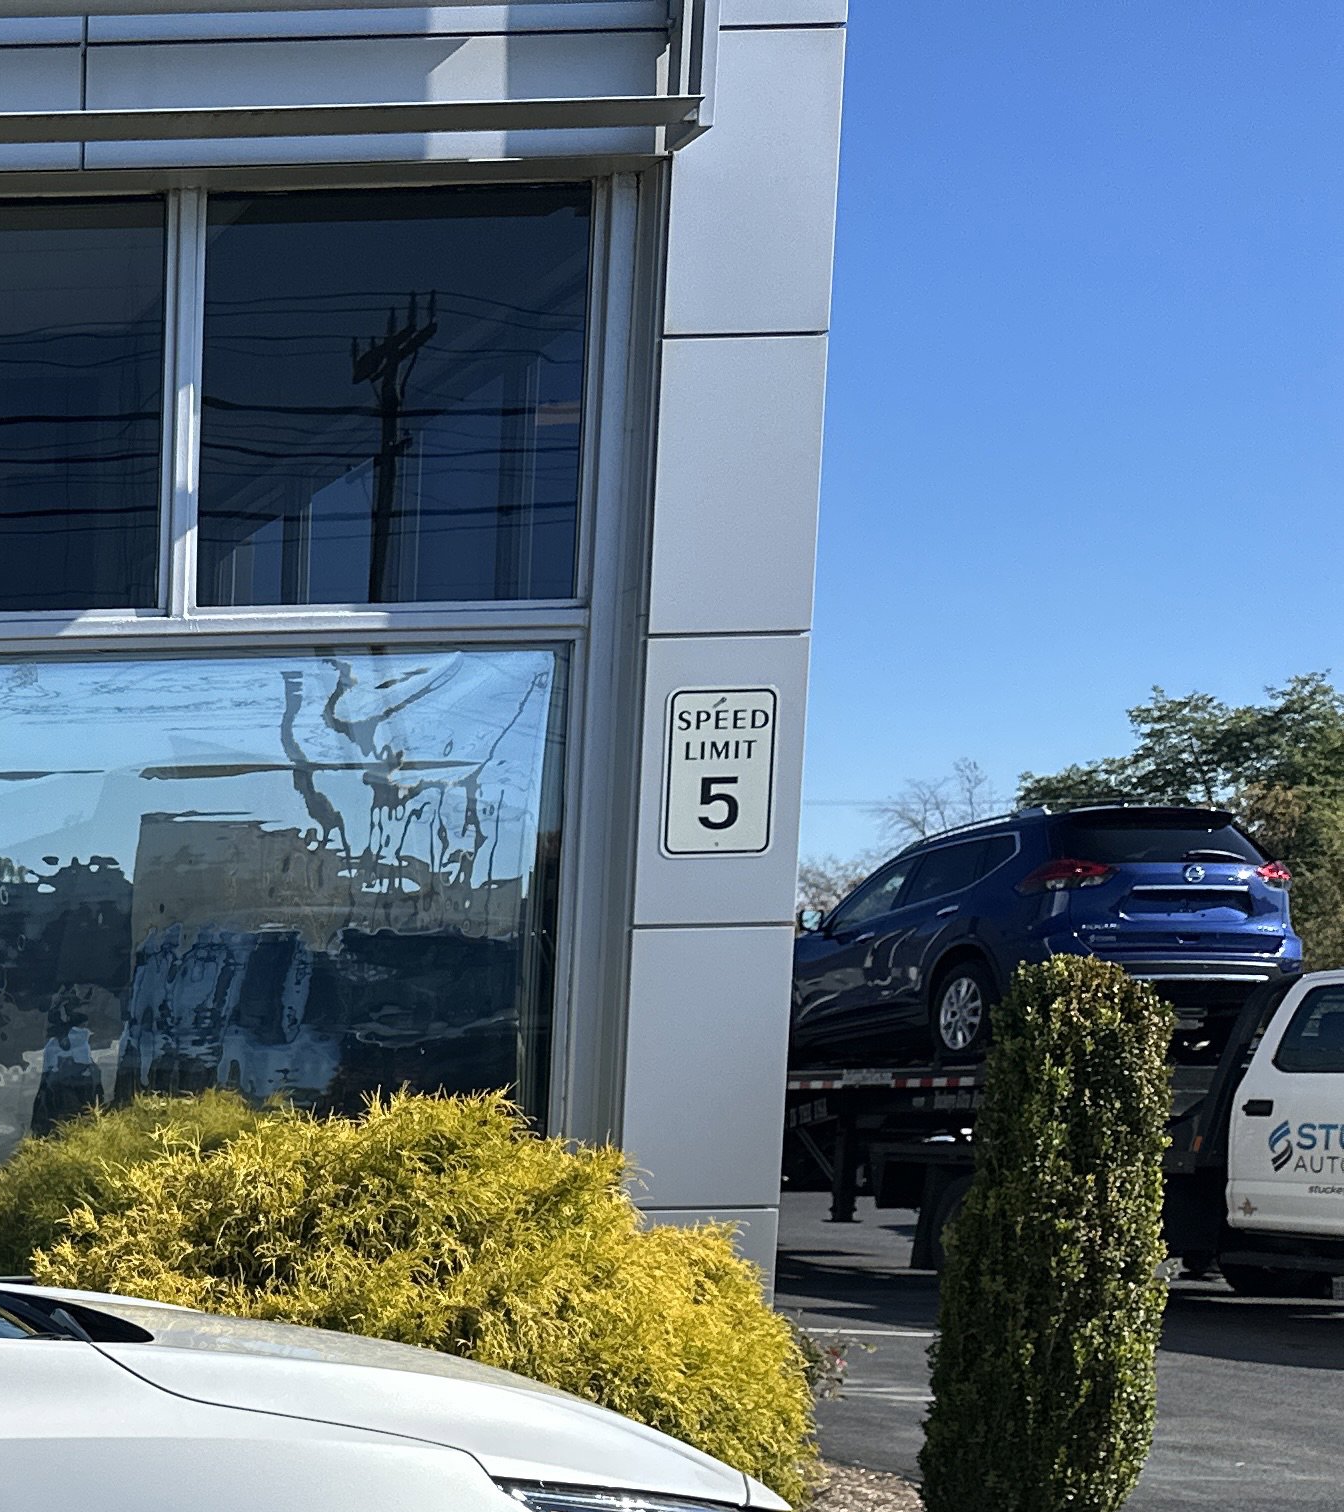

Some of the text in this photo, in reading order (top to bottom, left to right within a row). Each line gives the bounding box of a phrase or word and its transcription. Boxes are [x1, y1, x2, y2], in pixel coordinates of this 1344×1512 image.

[677, 708, 770, 731] SPEED
[685, 739, 758, 761] LIMIT
[698, 776, 740, 830] 5
[1296, 1123, 1344, 1150] ST
[1293, 1155, 1344, 1174] AUT
[1306, 1183, 1344, 1196] stucke
